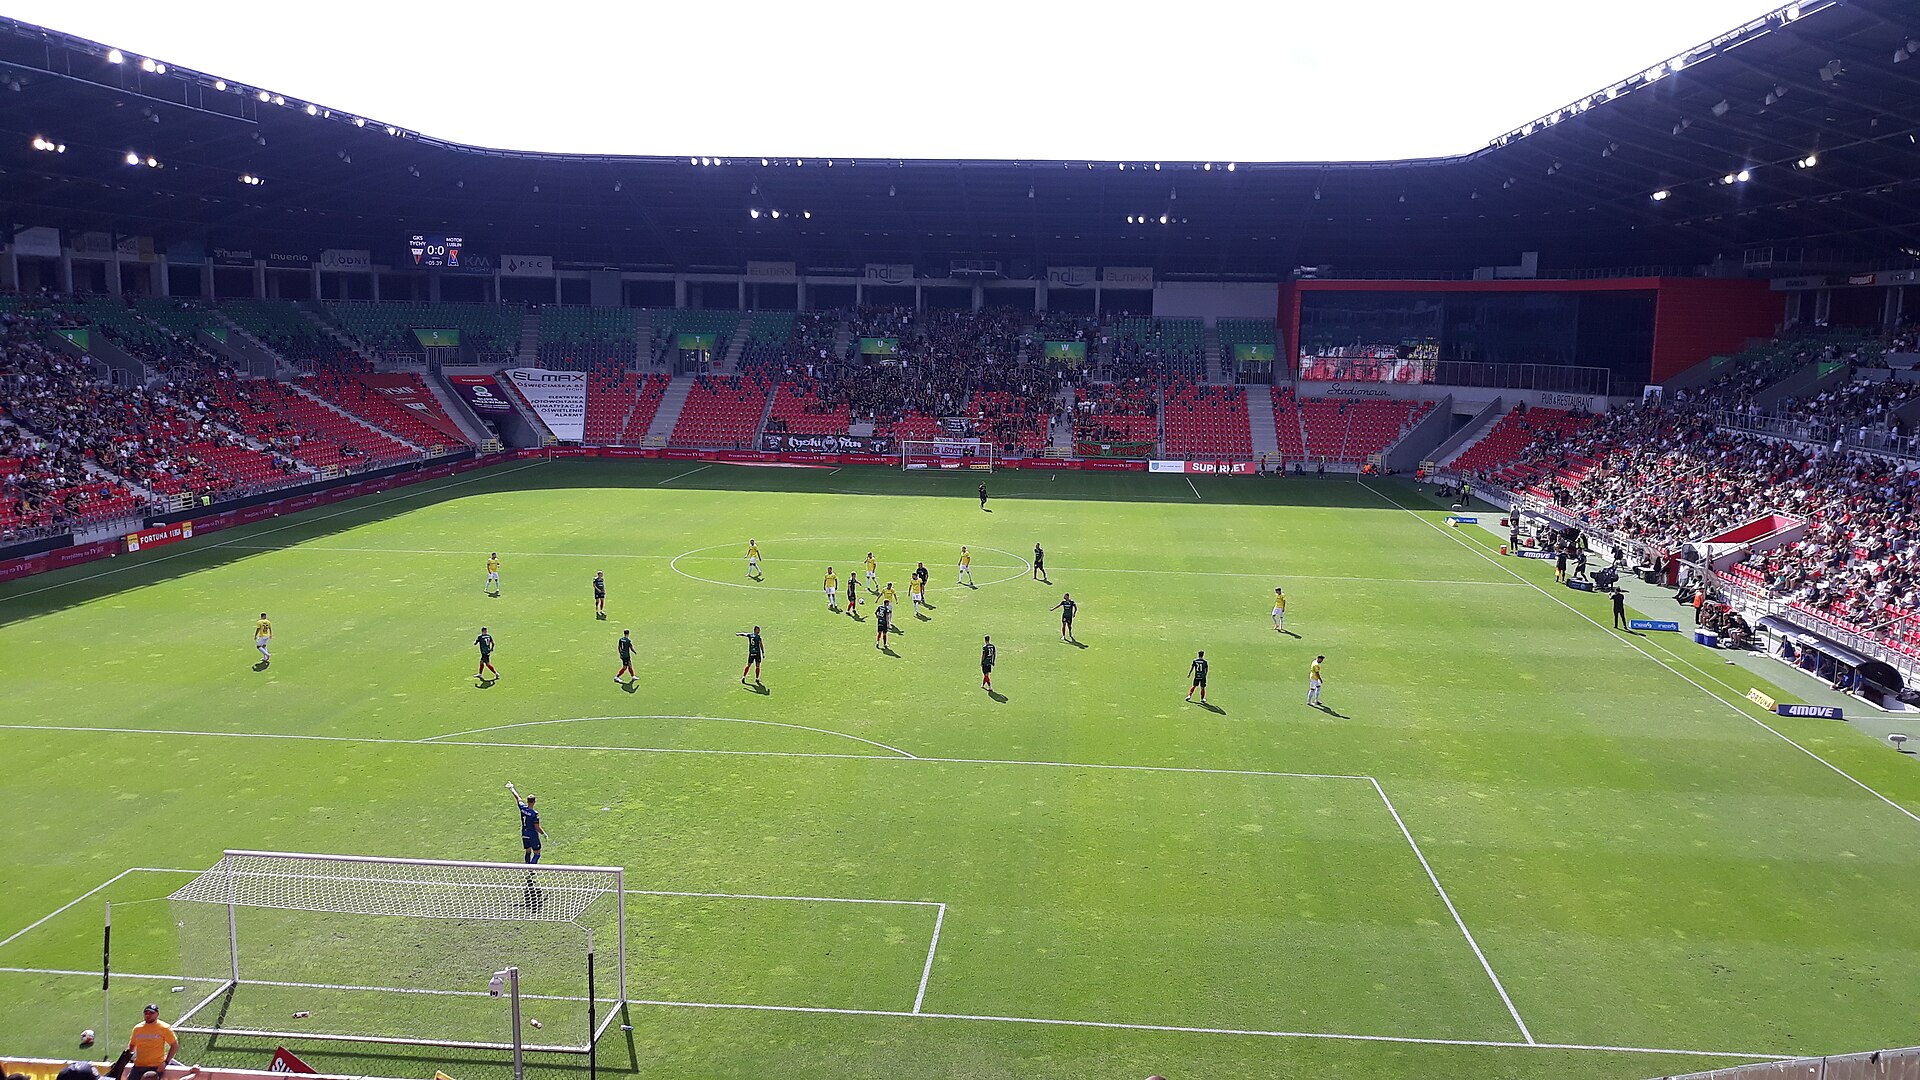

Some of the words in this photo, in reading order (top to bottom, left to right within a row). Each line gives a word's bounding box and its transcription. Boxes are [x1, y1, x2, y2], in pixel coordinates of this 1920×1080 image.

[427, 245, 445, 255] 0:0
[513, 371, 584, 381] ELMAX
[1192, 462, 1248, 473] SUPRET
[140, 531, 168, 544] FORTUNA
[1788, 705, 1834, 717] 4MOVE
